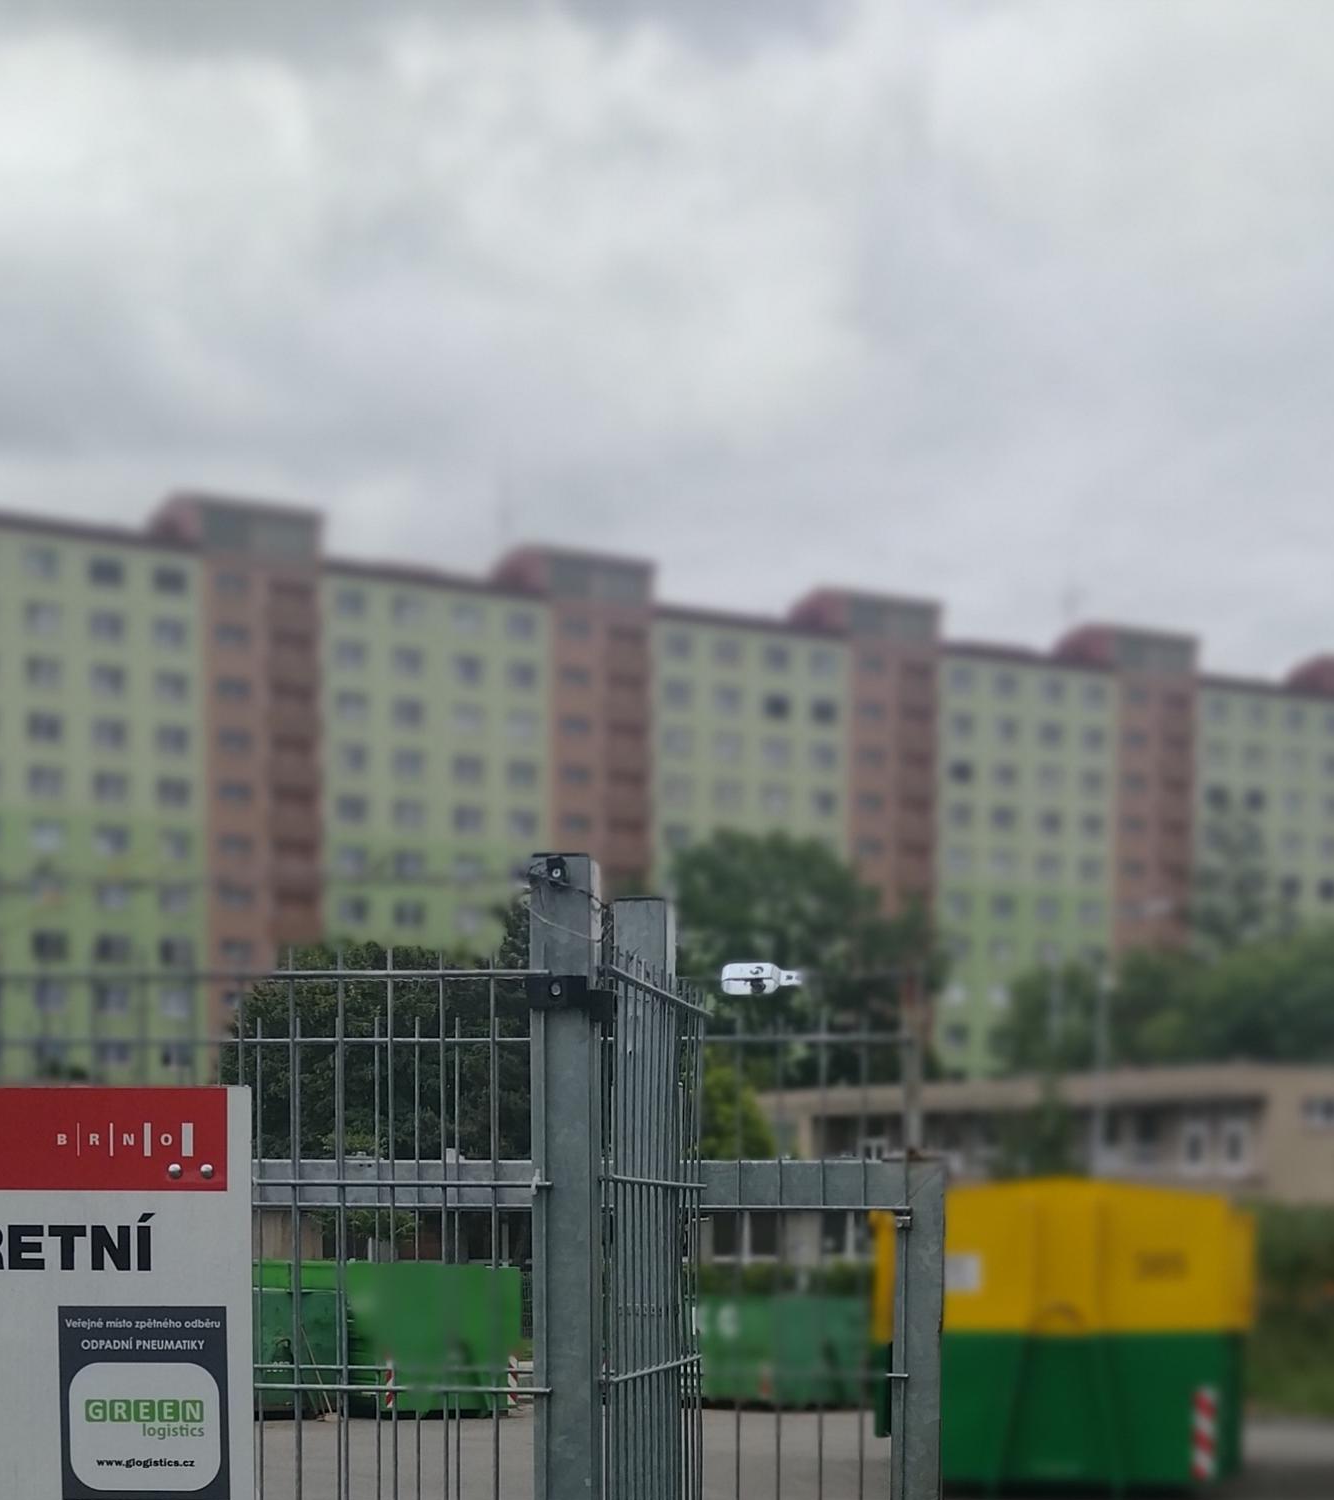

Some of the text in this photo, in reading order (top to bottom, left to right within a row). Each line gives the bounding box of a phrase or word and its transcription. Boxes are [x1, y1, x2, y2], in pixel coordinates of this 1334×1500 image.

[65, 1318, 220, 1330] Veřejné místo zpětného odběru
[81, 1337, 205, 1350] ODPADNÍ PNEUMATIKY
[88, 1401, 201, 1420] GREEN
[143, 1424, 205, 1440] logistics
[97, 1458, 195, 1468] www.glogistics.cz
